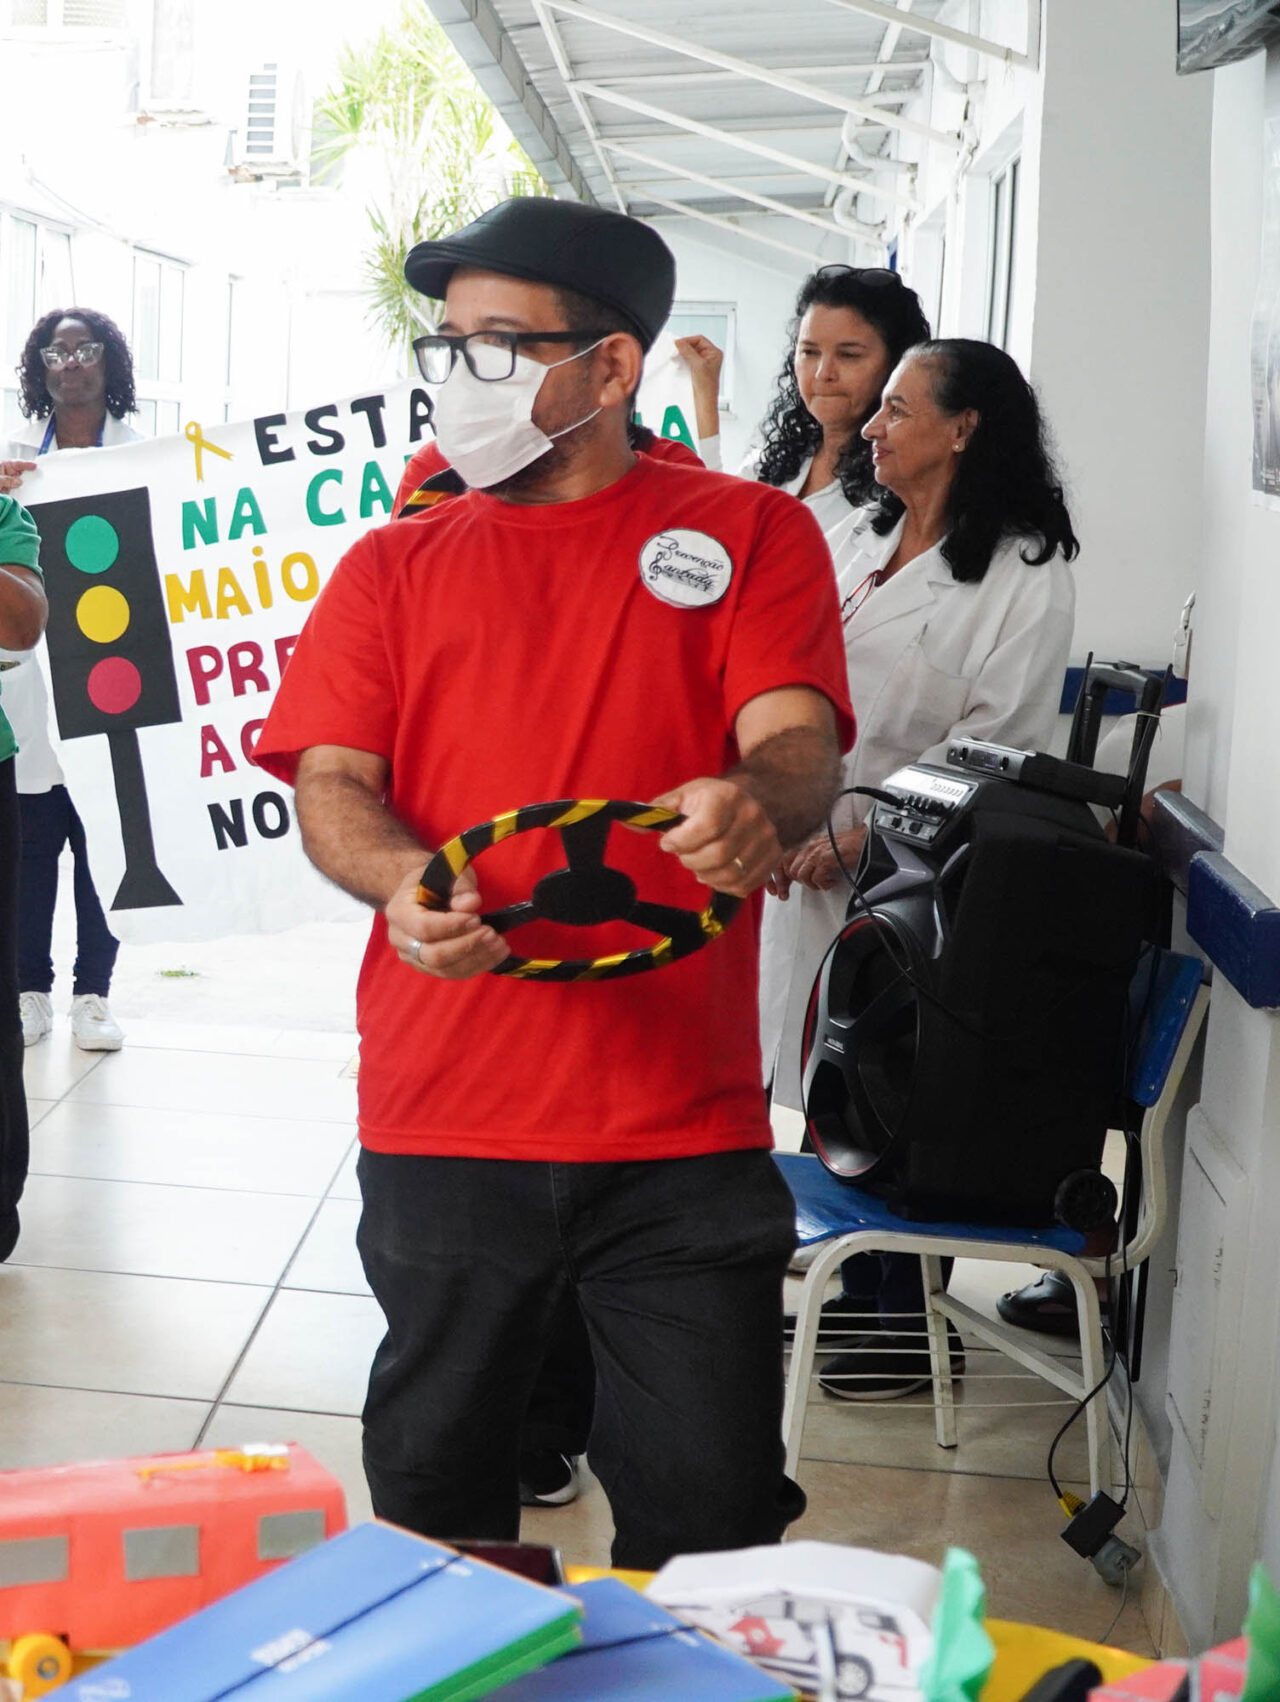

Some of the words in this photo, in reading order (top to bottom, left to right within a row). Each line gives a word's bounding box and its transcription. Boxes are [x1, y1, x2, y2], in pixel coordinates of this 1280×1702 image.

[182, 486, 268, 550] NA
[306, 454, 412, 527] CA
[207, 791, 290, 851] NO
